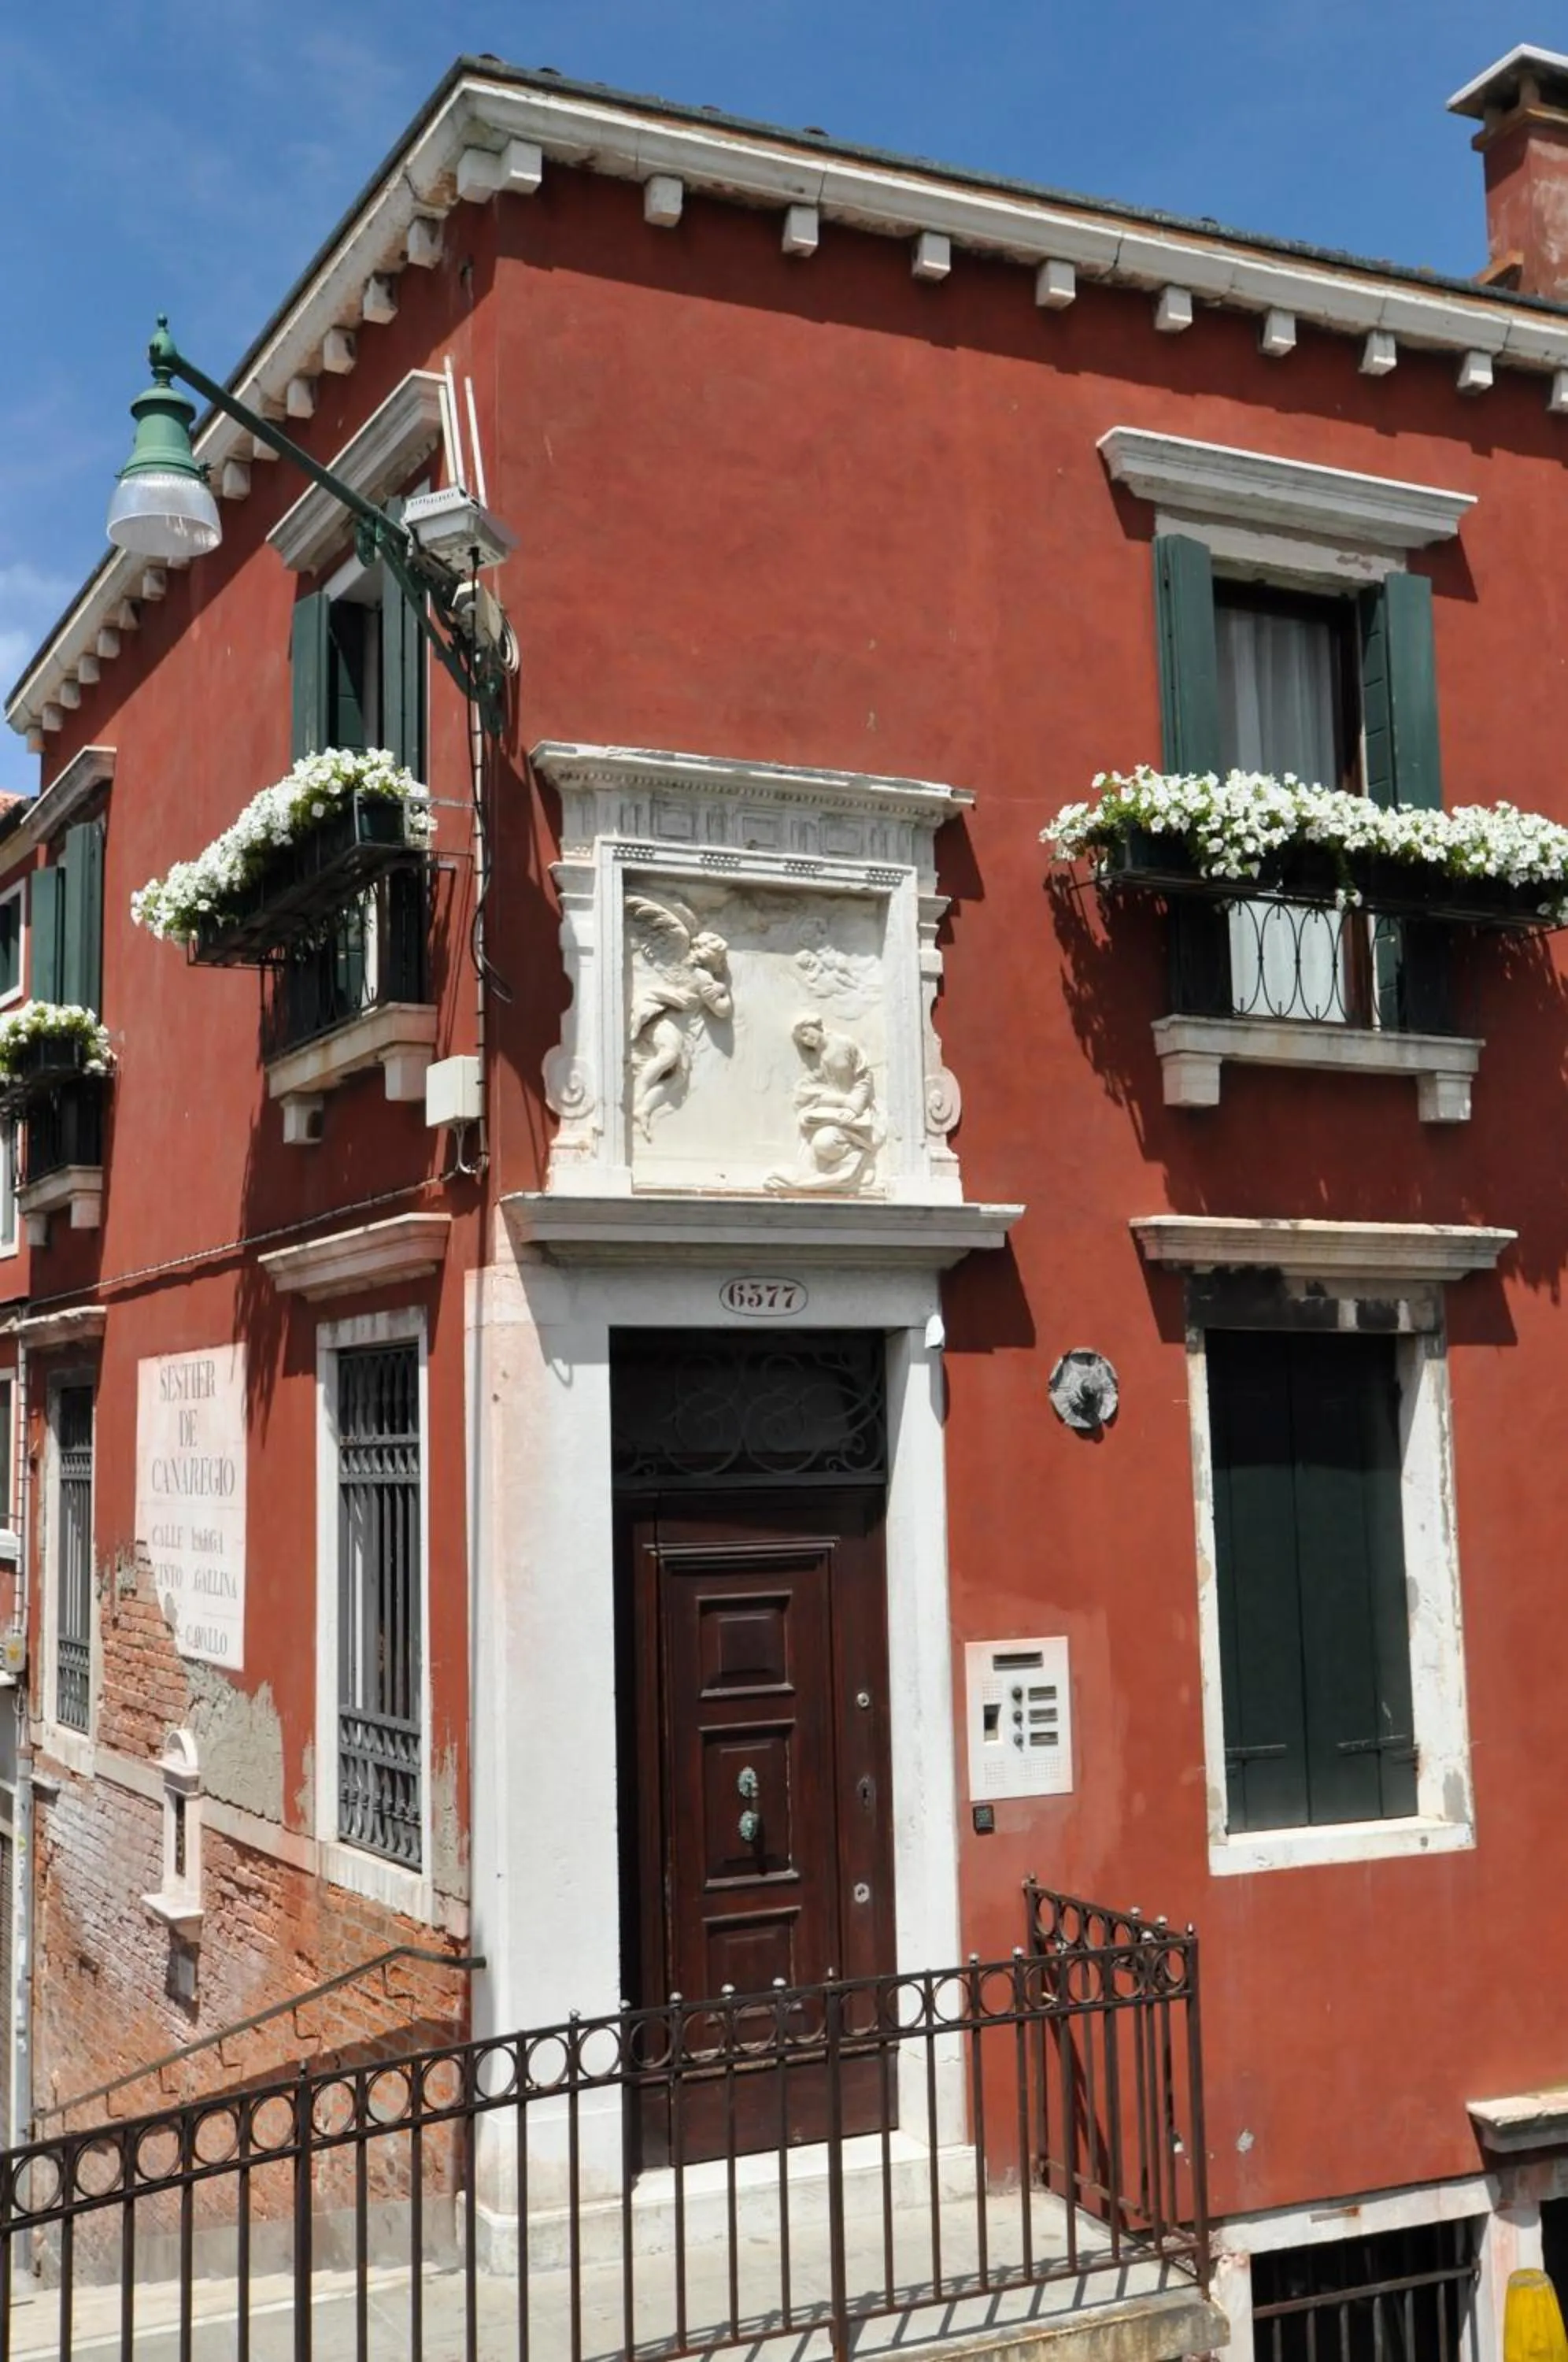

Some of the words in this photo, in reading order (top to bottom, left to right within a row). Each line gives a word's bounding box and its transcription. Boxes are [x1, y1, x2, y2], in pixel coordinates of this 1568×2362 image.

[159, 1360, 216, 1401] SESTIER
[179, 1409, 198, 1447] DE
[151, 1457, 235, 1497] CANAREGIO
